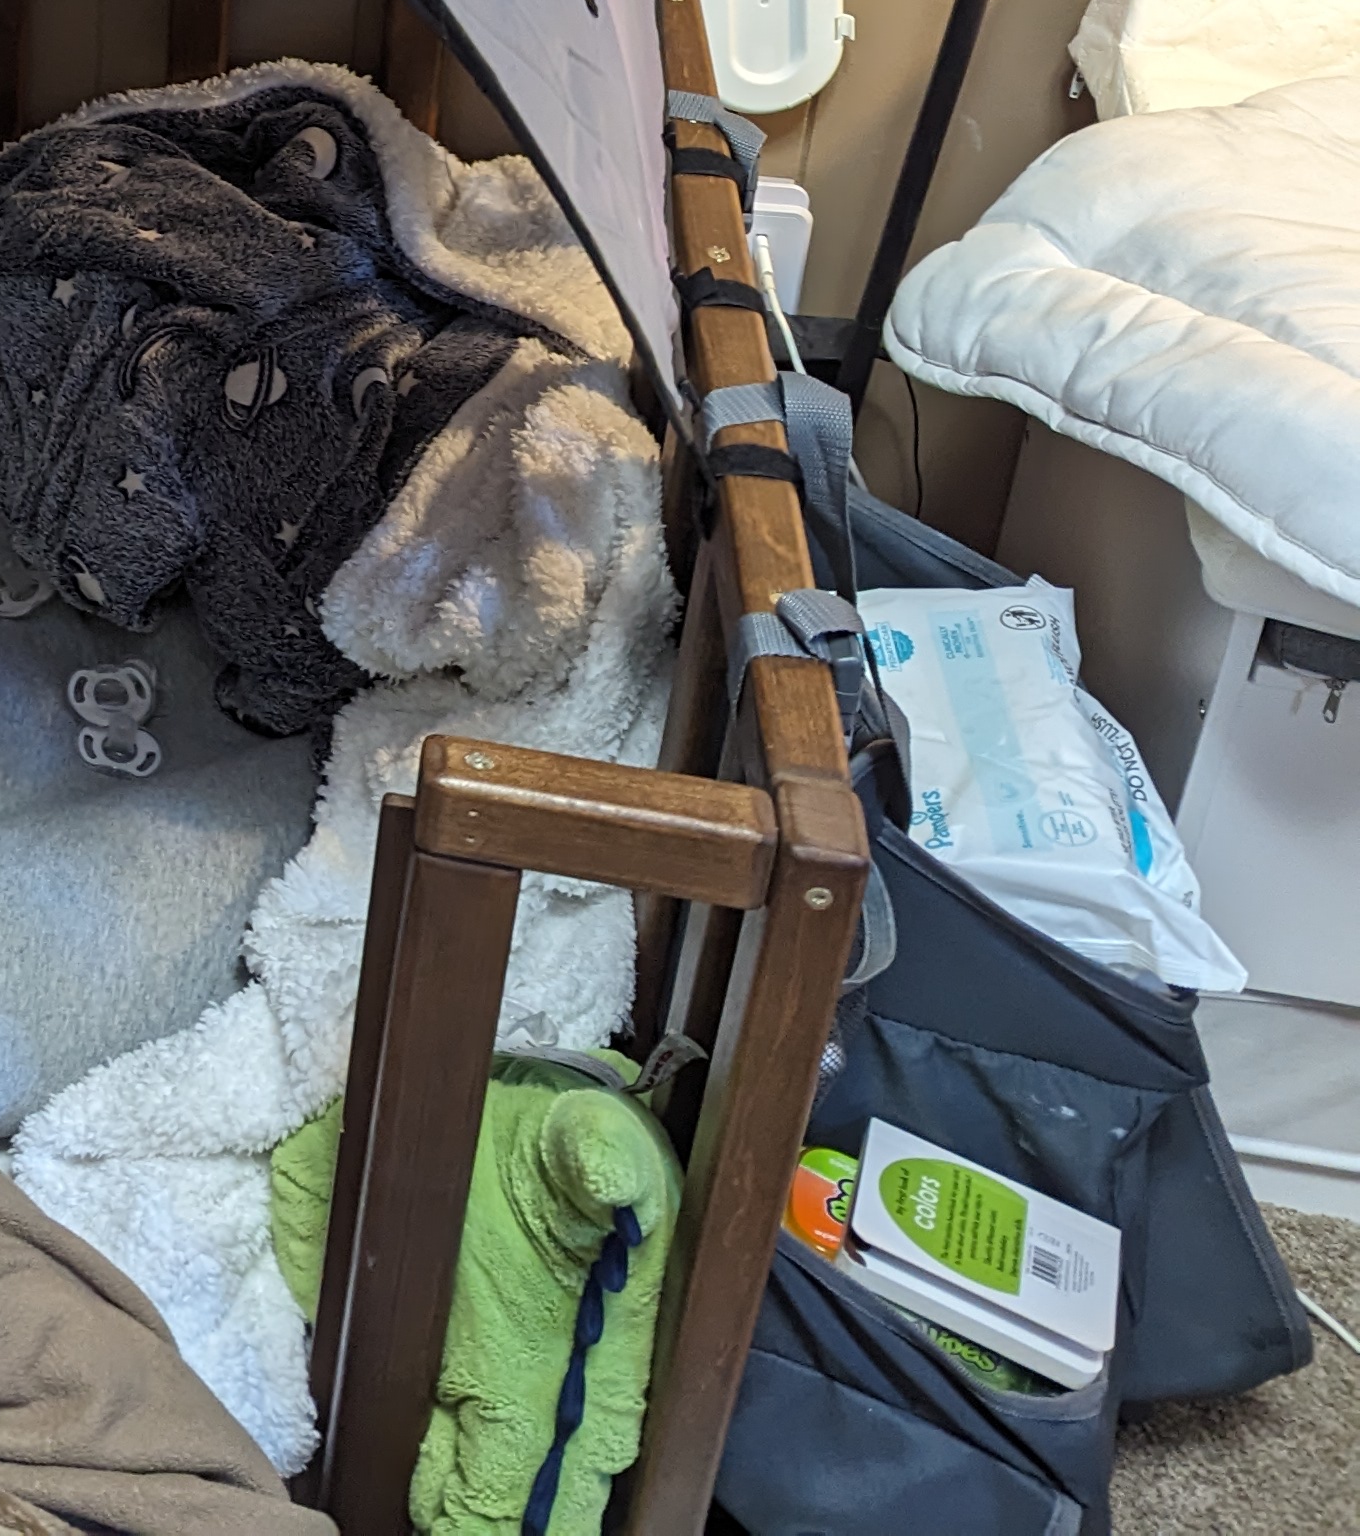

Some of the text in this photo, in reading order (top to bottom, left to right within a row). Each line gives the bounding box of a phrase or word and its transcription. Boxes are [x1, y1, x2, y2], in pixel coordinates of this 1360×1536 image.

[1117, 741, 1139, 772] NOT
[1130, 775, 1148, 802] DO
[921, 788, 954, 850] Pampers
[909, 1175, 941, 1230] colors
